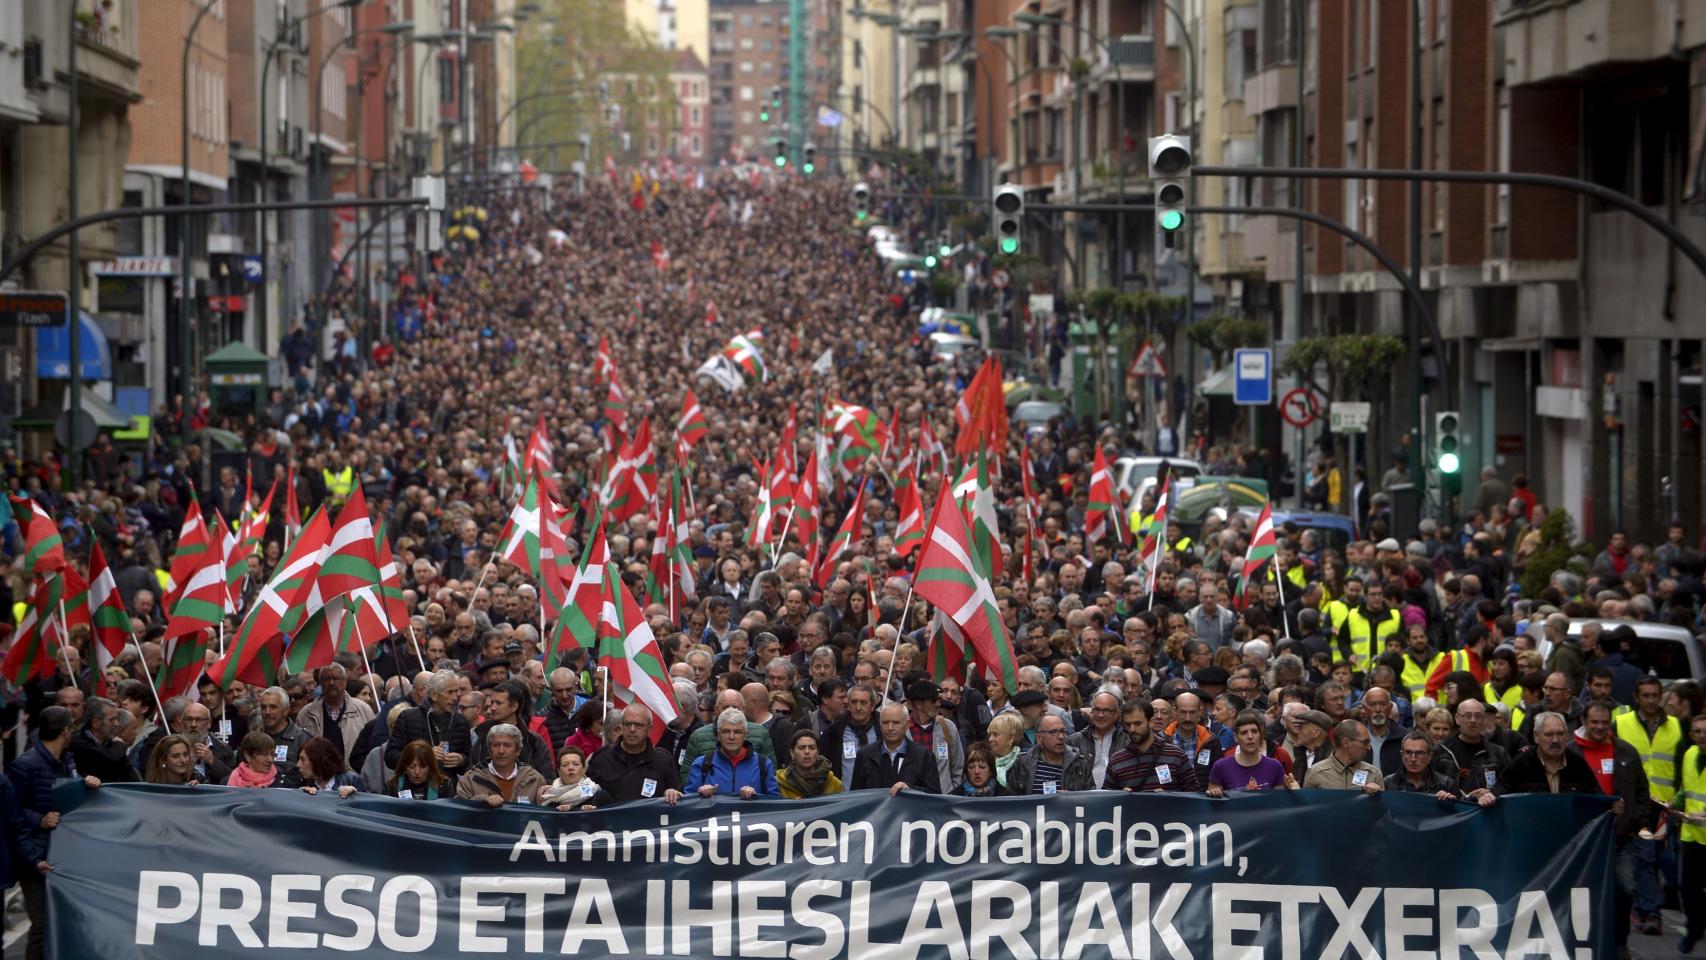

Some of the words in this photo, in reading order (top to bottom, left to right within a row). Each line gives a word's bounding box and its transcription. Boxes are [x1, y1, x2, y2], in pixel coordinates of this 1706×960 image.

[508, 814, 874, 866] Amnistiaren
[900, 806, 1249, 877] norabidean,
[135, 871, 438, 951] PRESO
[458, 876, 630, 955] ETA
[645, 879, 1193, 960] IHESLARIAK
[1211, 883, 1593, 960] ETXERA!
